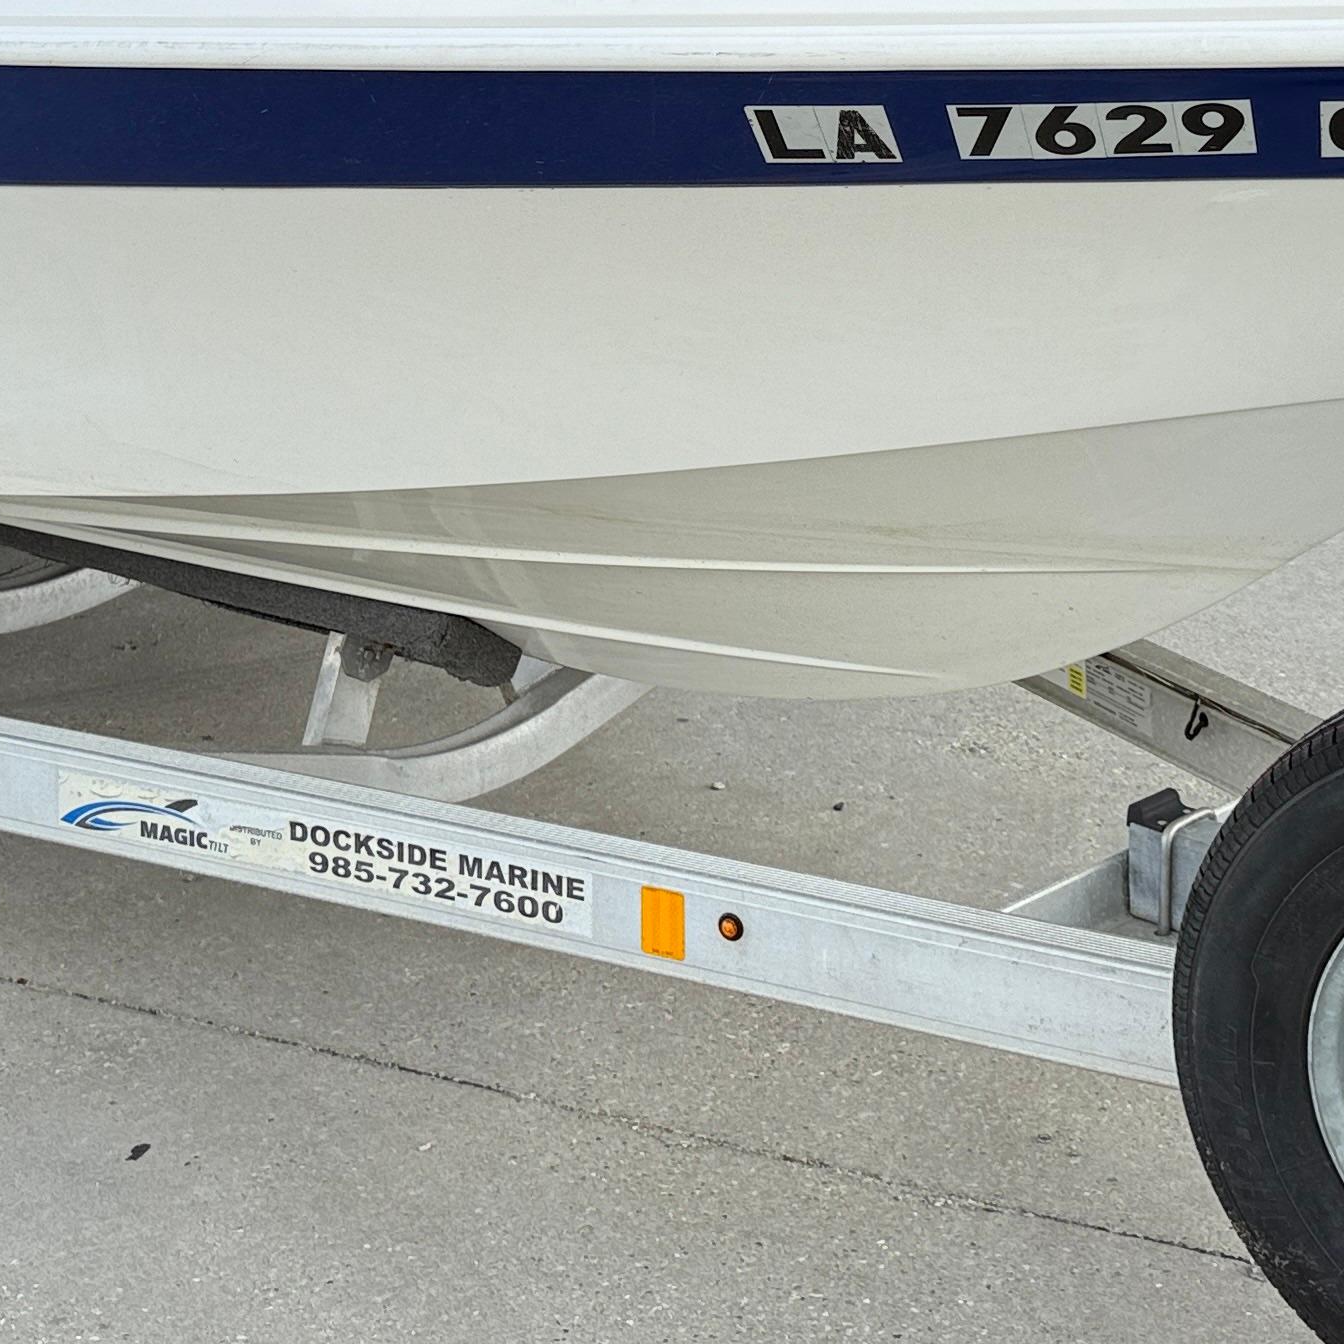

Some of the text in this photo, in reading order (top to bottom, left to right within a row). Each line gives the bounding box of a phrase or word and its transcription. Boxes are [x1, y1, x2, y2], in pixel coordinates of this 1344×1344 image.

[753, 109, 898, 160] LA
[956, 102, 1246, 156] 7629
[139, 819, 208, 850] MAGIC
[289, 820, 586, 902] DOCKSIDE MARINE
[308, 851, 564, 924] 985-732-7600
